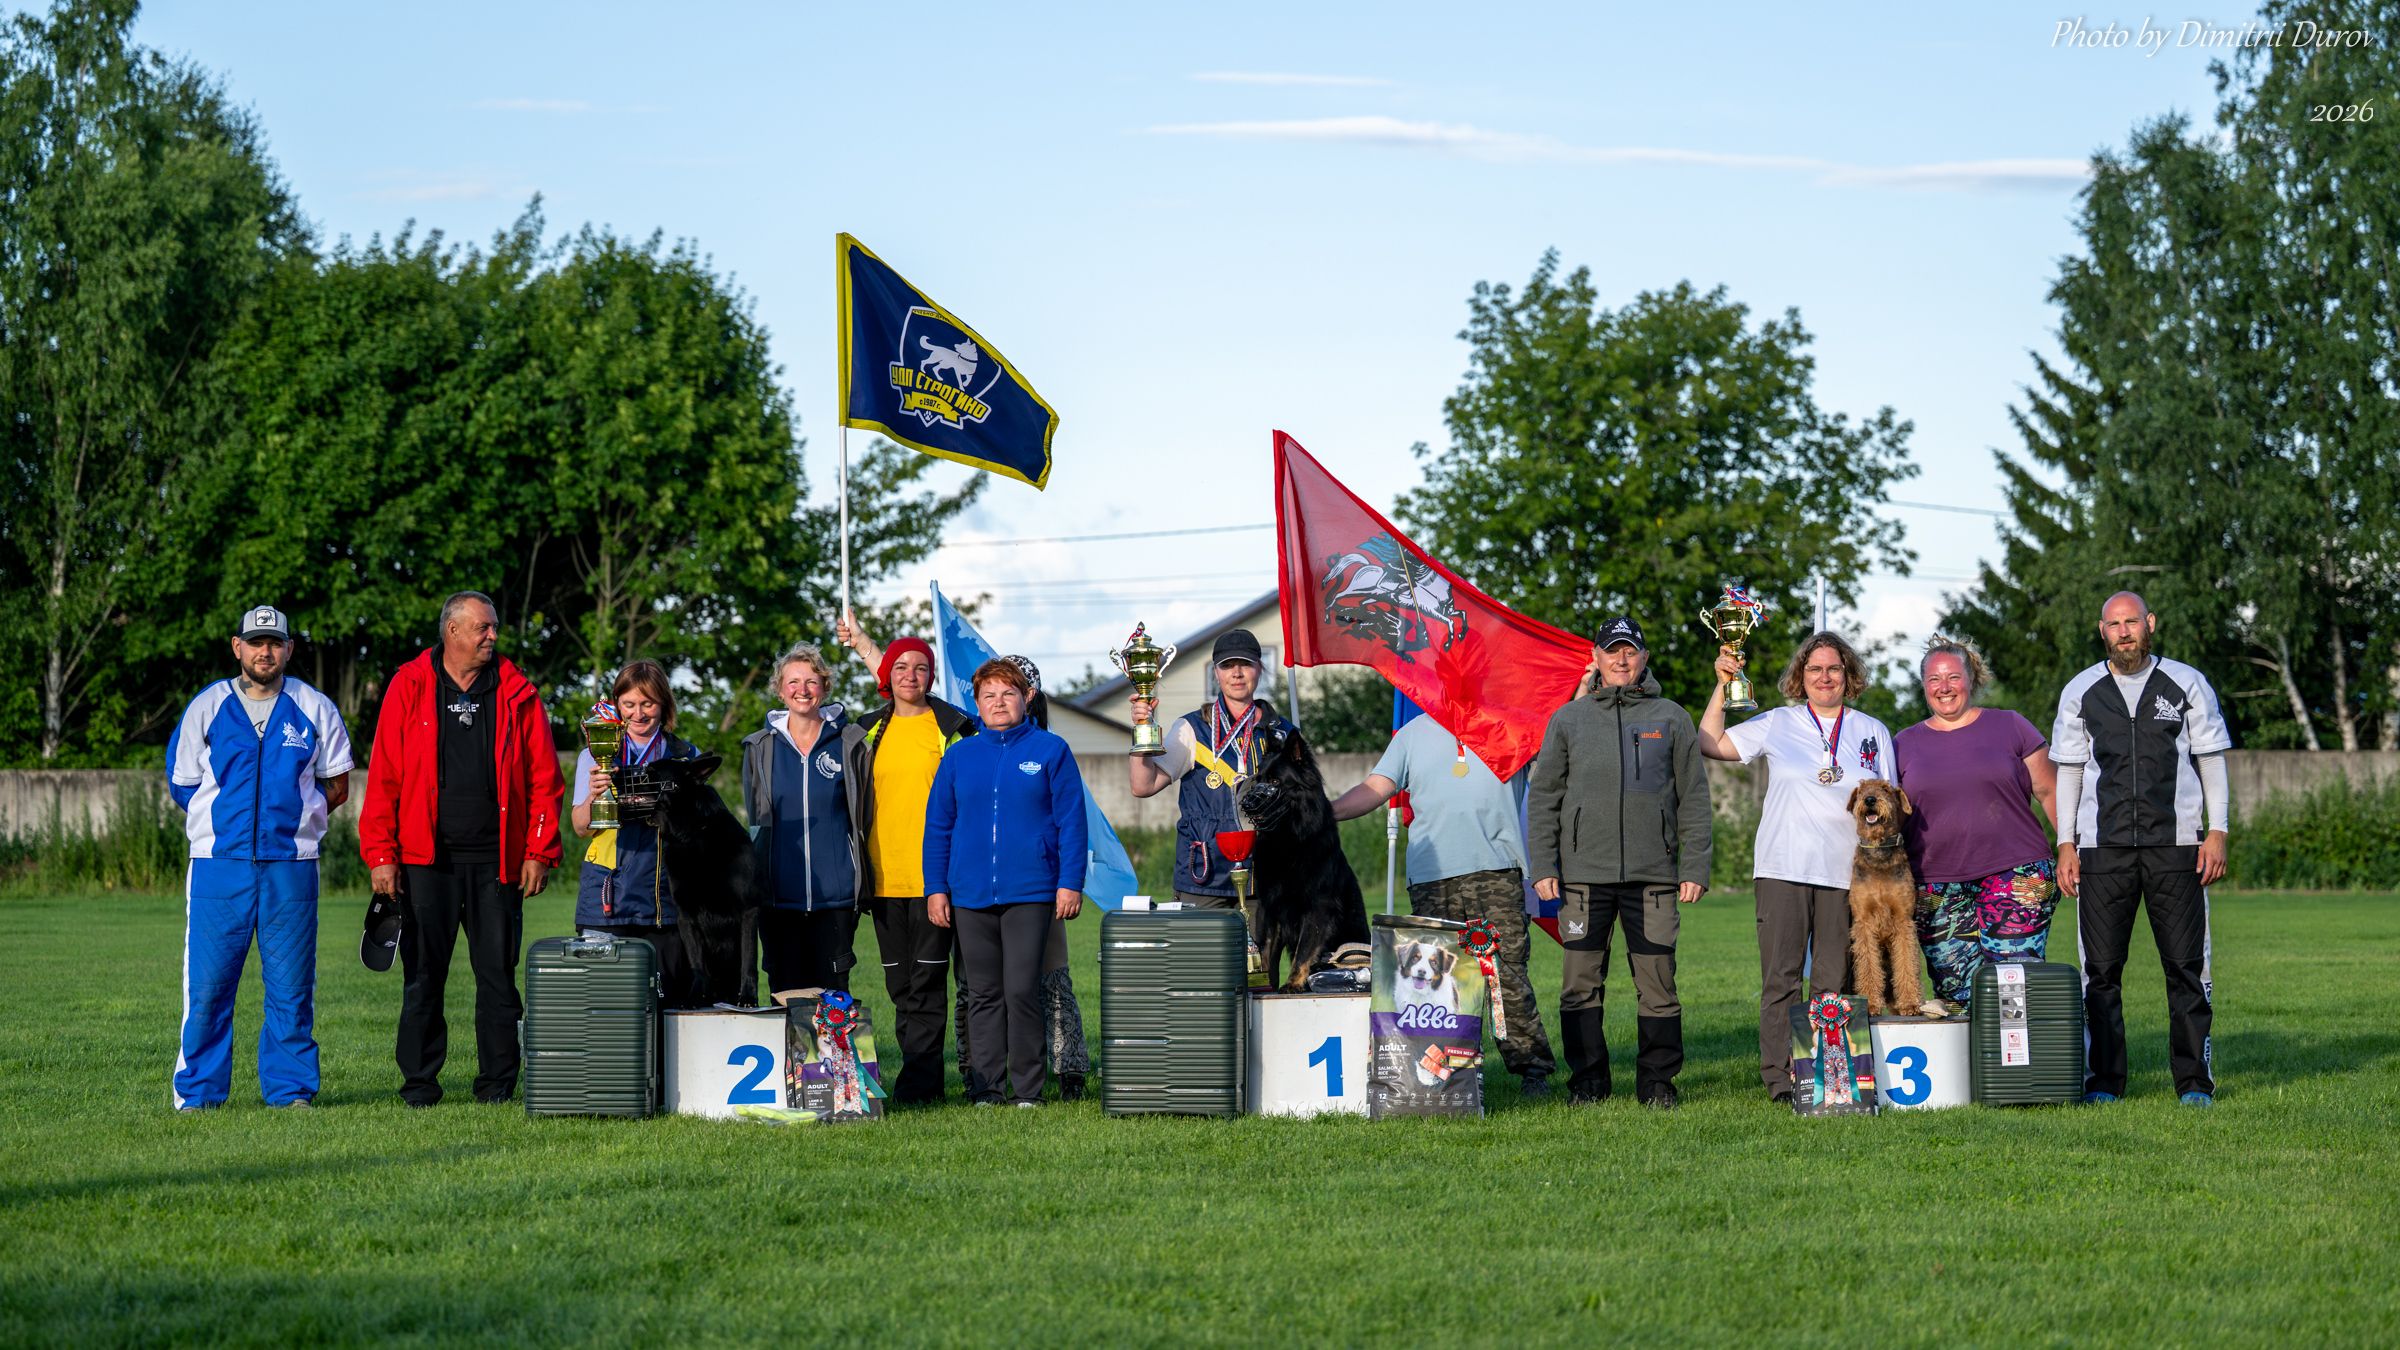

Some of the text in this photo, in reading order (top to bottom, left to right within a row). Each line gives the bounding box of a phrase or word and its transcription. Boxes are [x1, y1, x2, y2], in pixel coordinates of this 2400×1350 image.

[915, 371, 988, 419] СТРОГИНО
[1612, 627, 1632, 635] adidas
[727, 1044, 776, 1104] 2
[1308, 1036, 1344, 1097] 1
[1378, 1043, 1408, 1052] ADULT
[1885, 1046, 1932, 1105] 3
